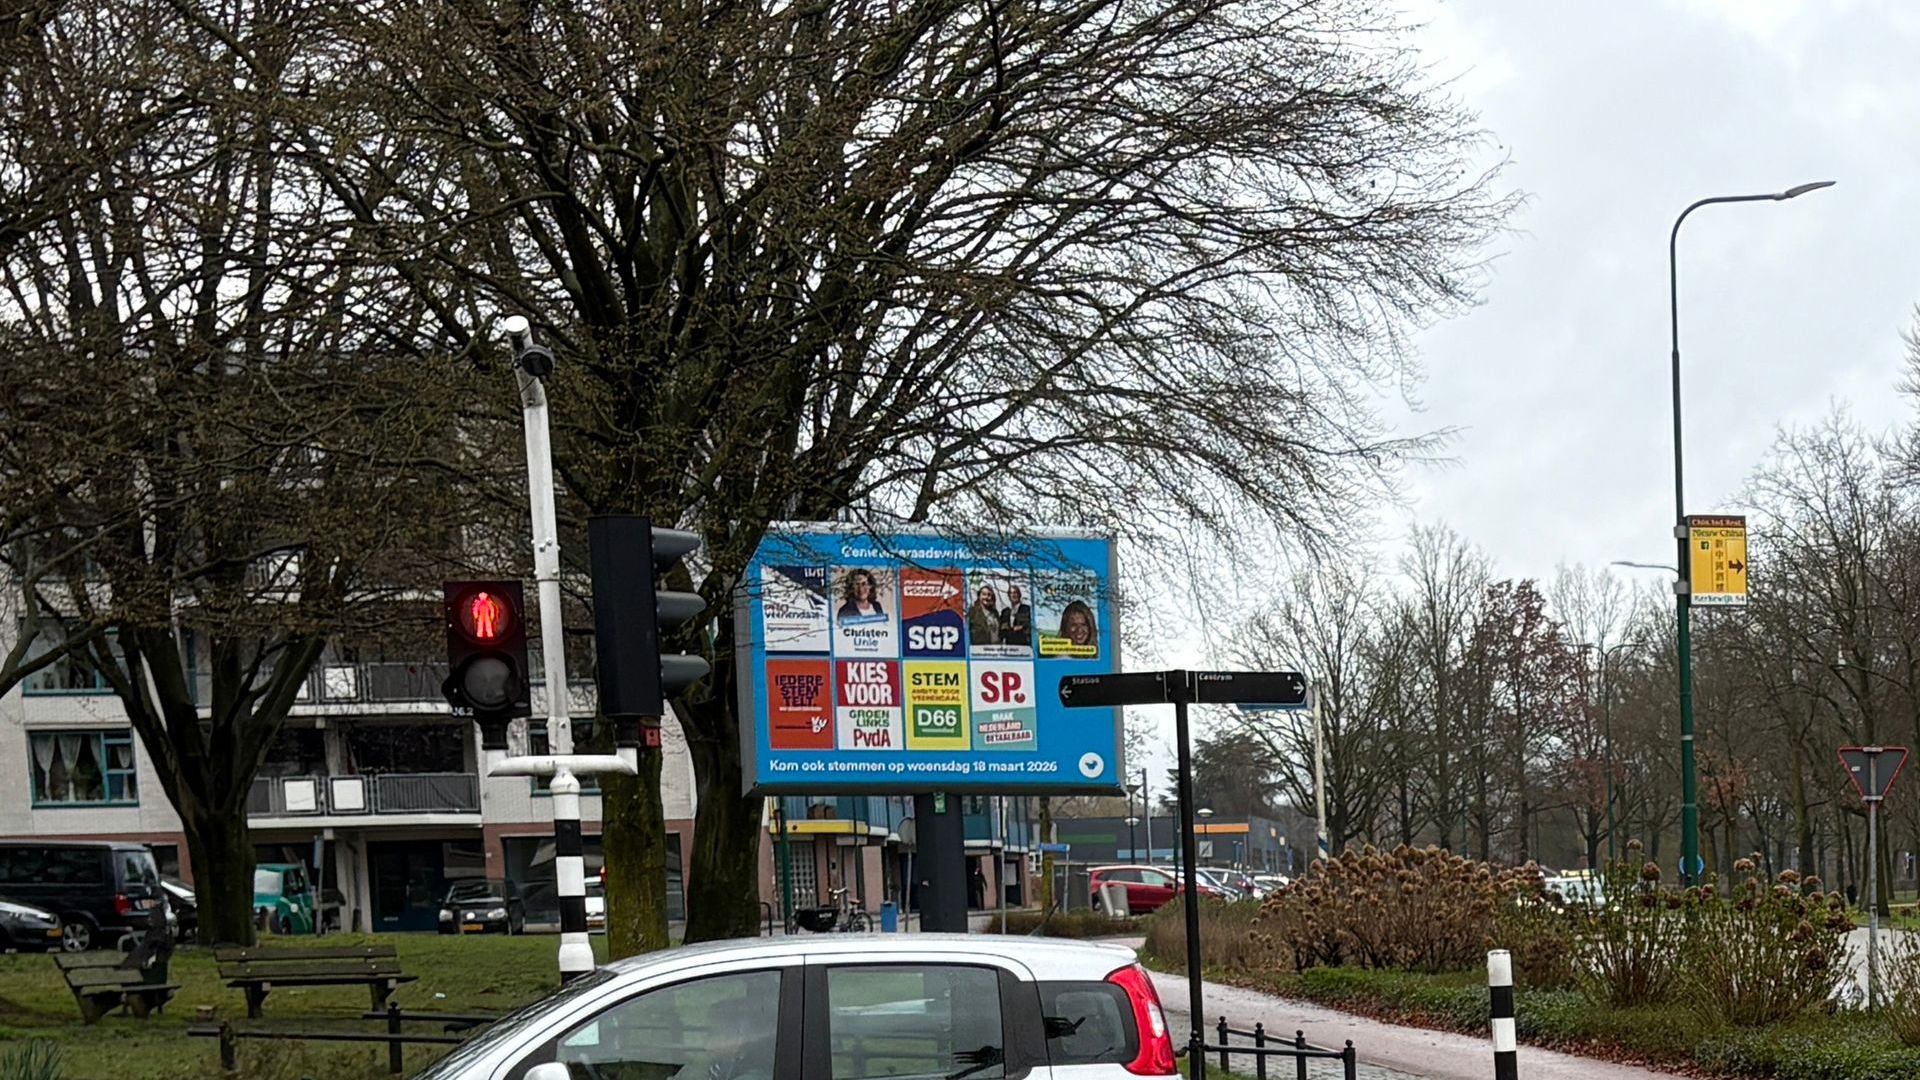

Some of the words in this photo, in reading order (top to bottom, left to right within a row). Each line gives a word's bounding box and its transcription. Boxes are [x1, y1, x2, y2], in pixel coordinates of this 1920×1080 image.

[843, 627, 889, 638] Christen
[908, 625, 960, 651] SGP
[853, 637, 879, 647] Unie
[847, 662, 889, 684] KIES
[1199, 673, 1233, 681] Centrum
[775, 675, 823, 687] IEDERE
[912, 673, 959, 686] STEM
[1072, 677, 1100, 685] Station
[780, 686, 819, 697] STEM
[844, 683, 893, 705] VOOR
[849, 709, 890, 719] GROEN
[917, 709, 957, 727] D66
[856, 719, 890, 727] LINKS
[853, 728, 891, 747] PvdA
[769, 760, 799, 772] Kom
[801, 760, 825, 772] ook
[828, 761, 886, 772] stemmen
[888, 763, 905, 773] op
[907, 761, 970, 774] woensdag
[973, 761, 986, 772] 18
[988, 761, 1024, 772] maart
[1026, 761, 1057, 772] 2026
